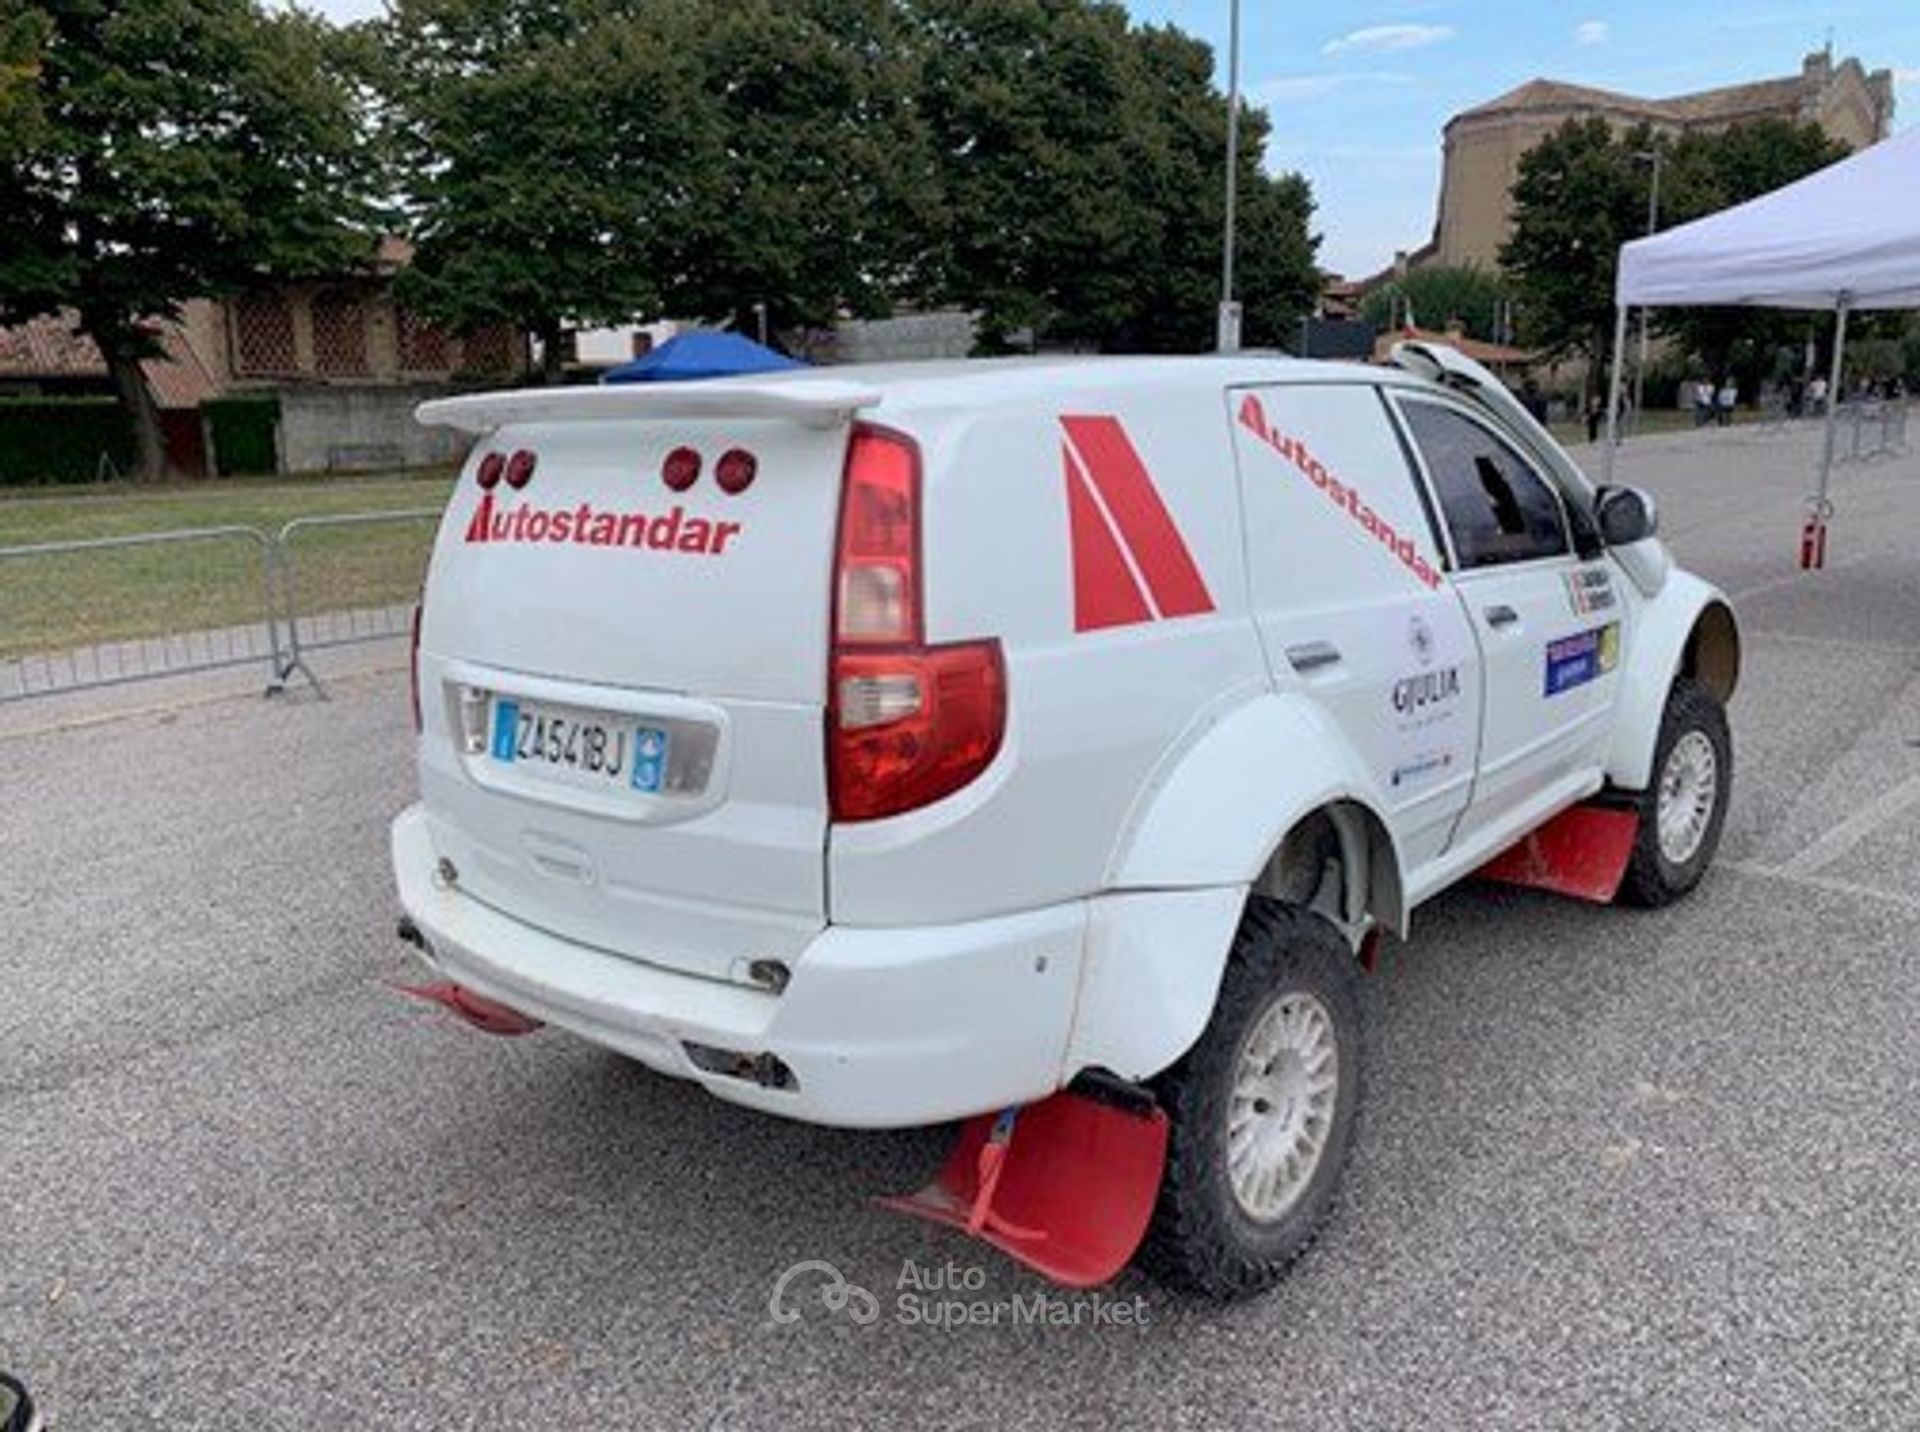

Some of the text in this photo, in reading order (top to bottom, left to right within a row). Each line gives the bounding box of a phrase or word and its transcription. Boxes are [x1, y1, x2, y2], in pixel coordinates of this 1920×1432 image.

[1239, 394, 1442, 589] Autostandar
[464, 494, 741, 554] Autostandar
[516, 713, 626, 776] ZA541BJ
